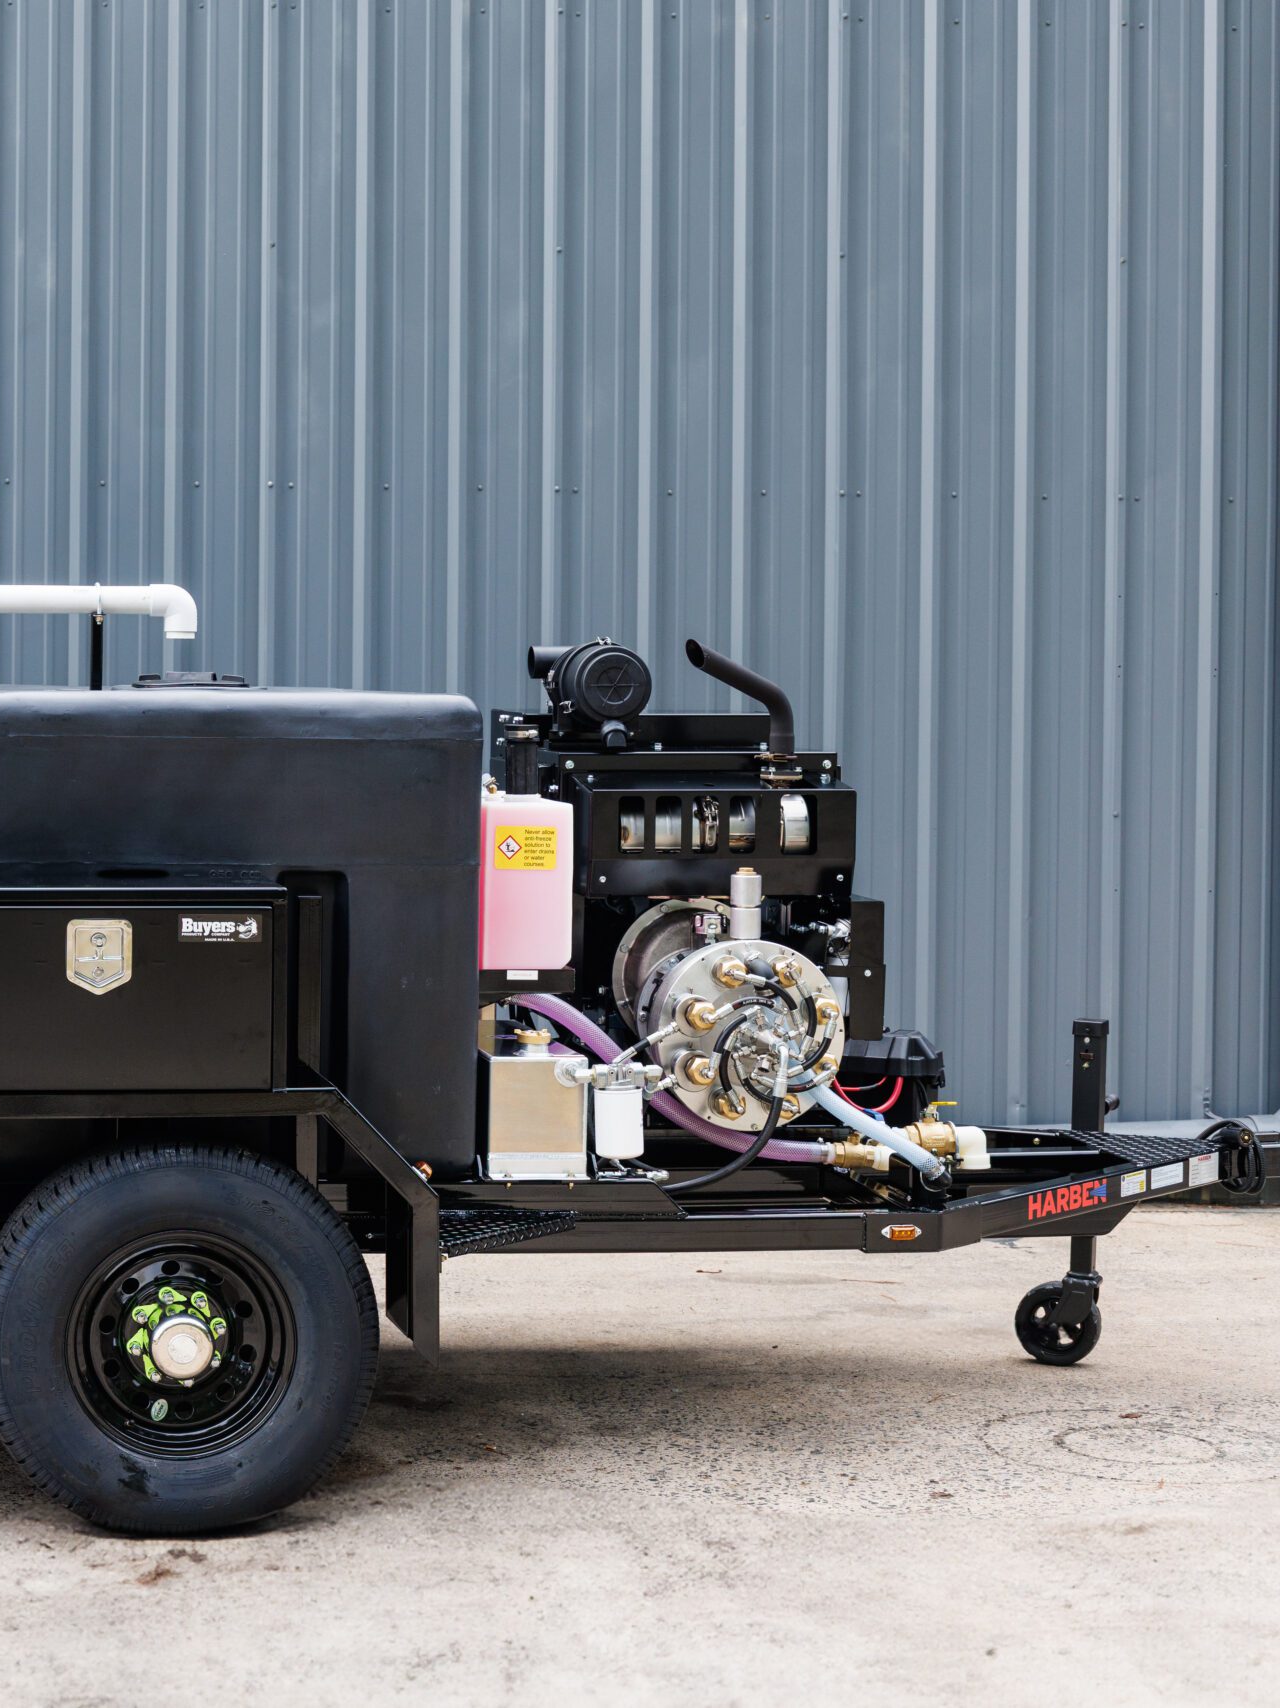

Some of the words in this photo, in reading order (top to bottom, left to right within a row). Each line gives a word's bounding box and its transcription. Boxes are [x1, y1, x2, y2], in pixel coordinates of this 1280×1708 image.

[181, 917, 236, 935] Buyers
[1028, 1178, 1107, 1220] HARBEN
[23, 1239, 76, 1393] PROVIDER
